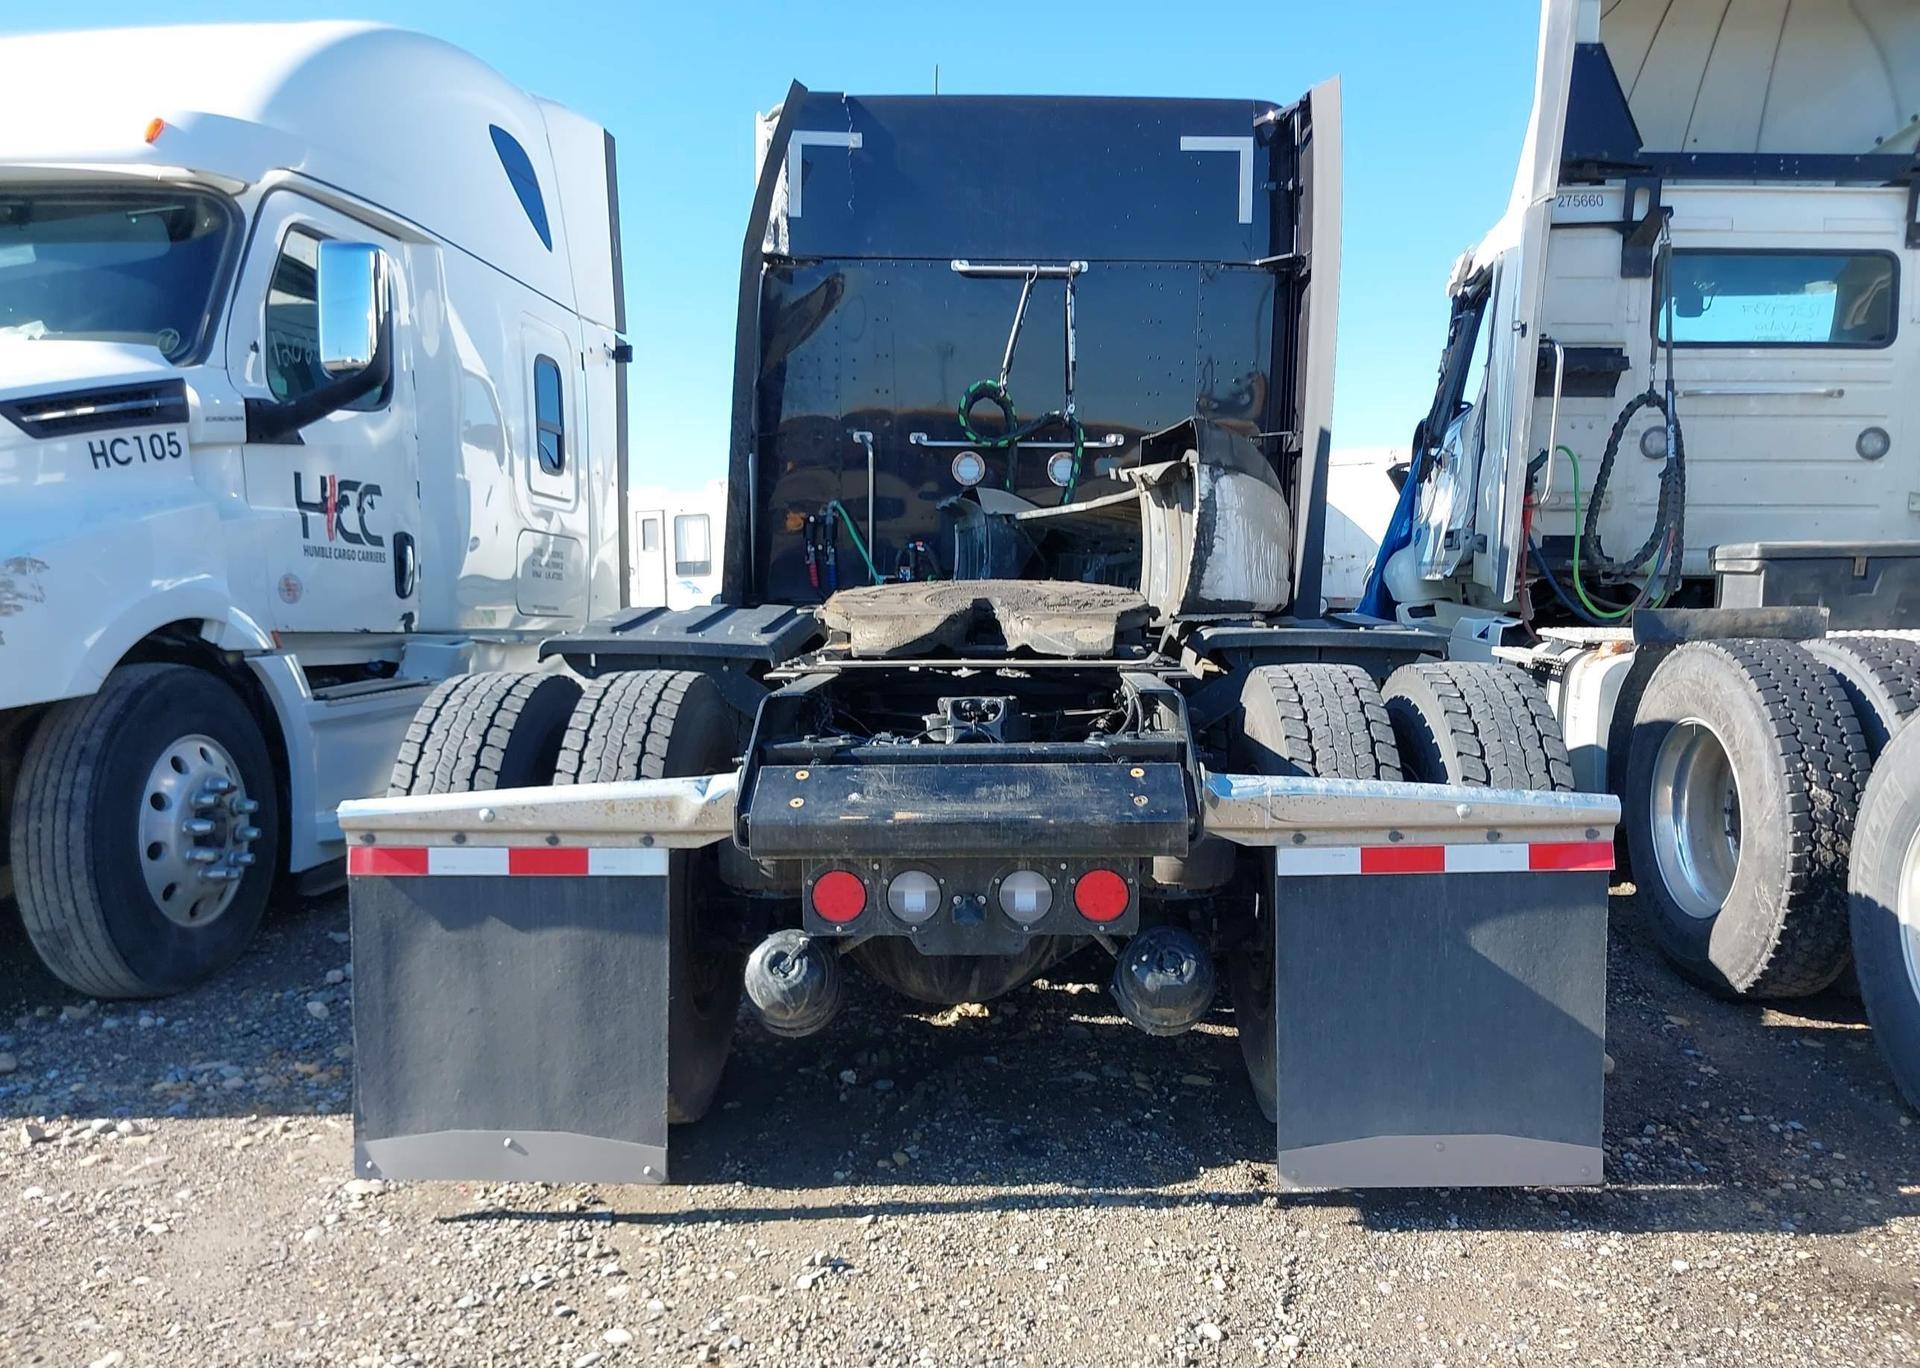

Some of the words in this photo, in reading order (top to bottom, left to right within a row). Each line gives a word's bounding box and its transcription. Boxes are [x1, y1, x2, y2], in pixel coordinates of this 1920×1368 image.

[1557, 194, 1604, 208] 275660
[88, 431, 182, 470] HC105
[303, 544, 332, 559] HUMBLE
[333, 547, 357, 561] CARGO
[357, 550, 386, 563] CARRIERS
